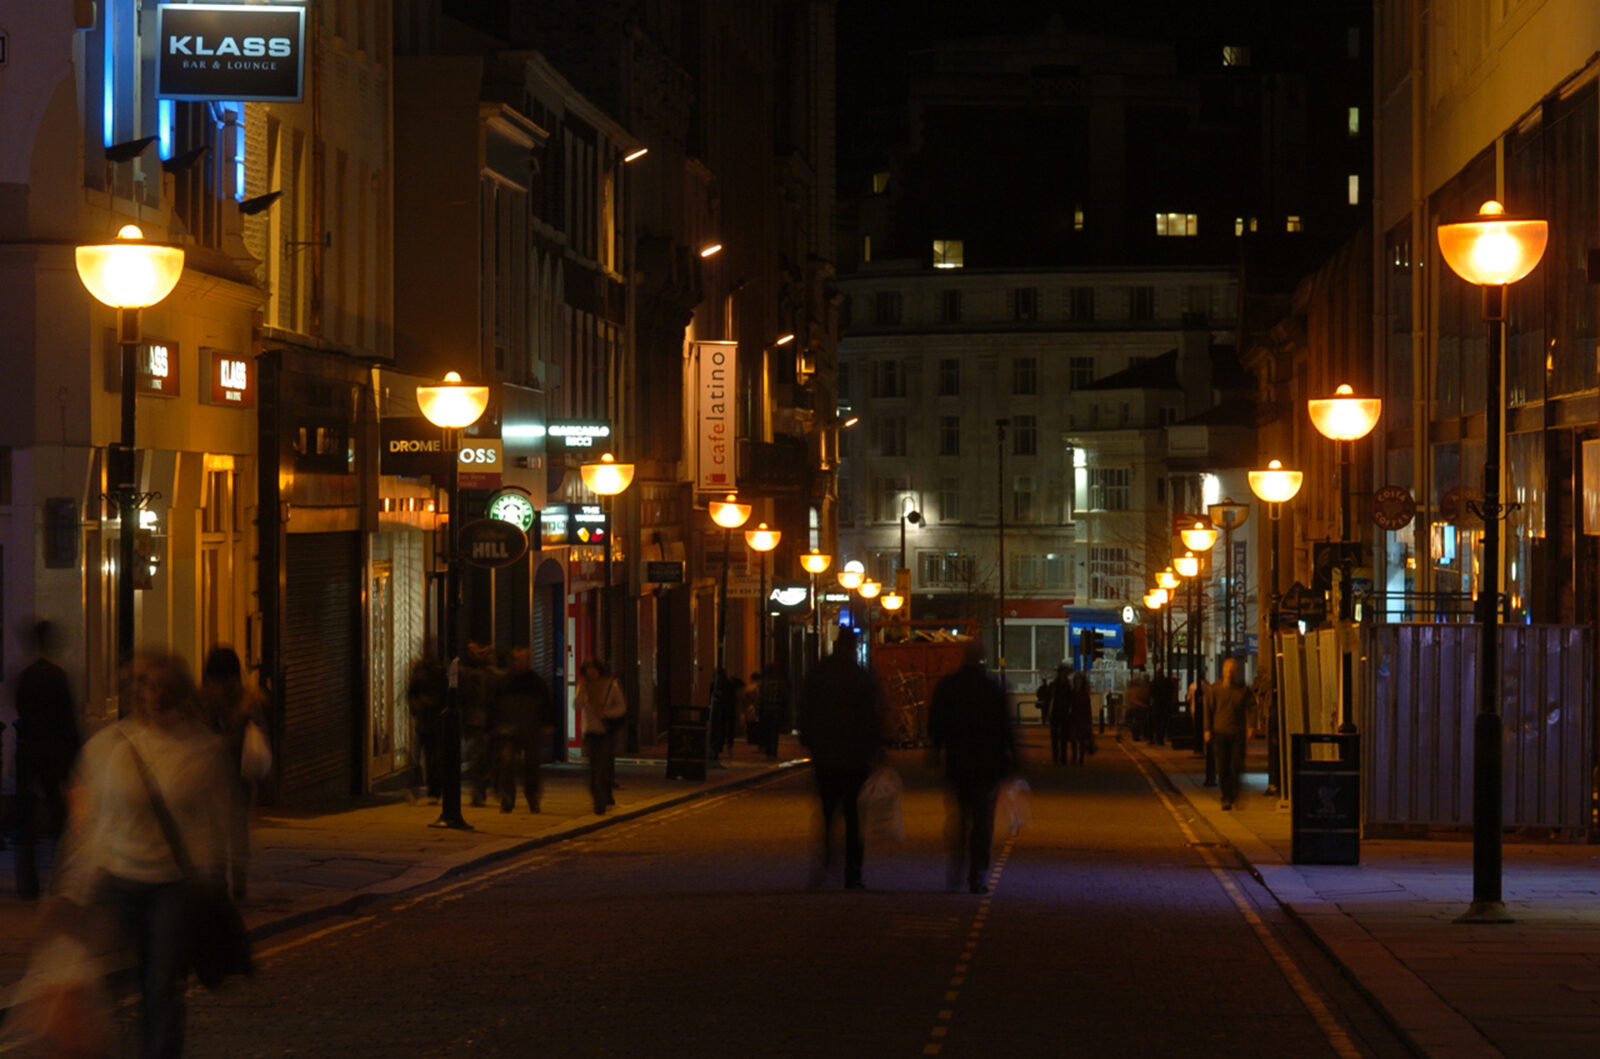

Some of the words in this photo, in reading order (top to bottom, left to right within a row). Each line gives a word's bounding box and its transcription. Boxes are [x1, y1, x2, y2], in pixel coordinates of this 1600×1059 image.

[169, 35, 291, 57] KLASS
[182, 60, 207, 69] BAR
[212, 61, 221, 70] &
[227, 61, 278, 71] LOUNGE
[706, 352, 725, 464] cafelatino
[389, 440, 440, 453] DROME
[458, 448, 496, 463] OSS
[1376, 489, 1407, 503] COSTA
[472, 541, 509, 558] HILL
